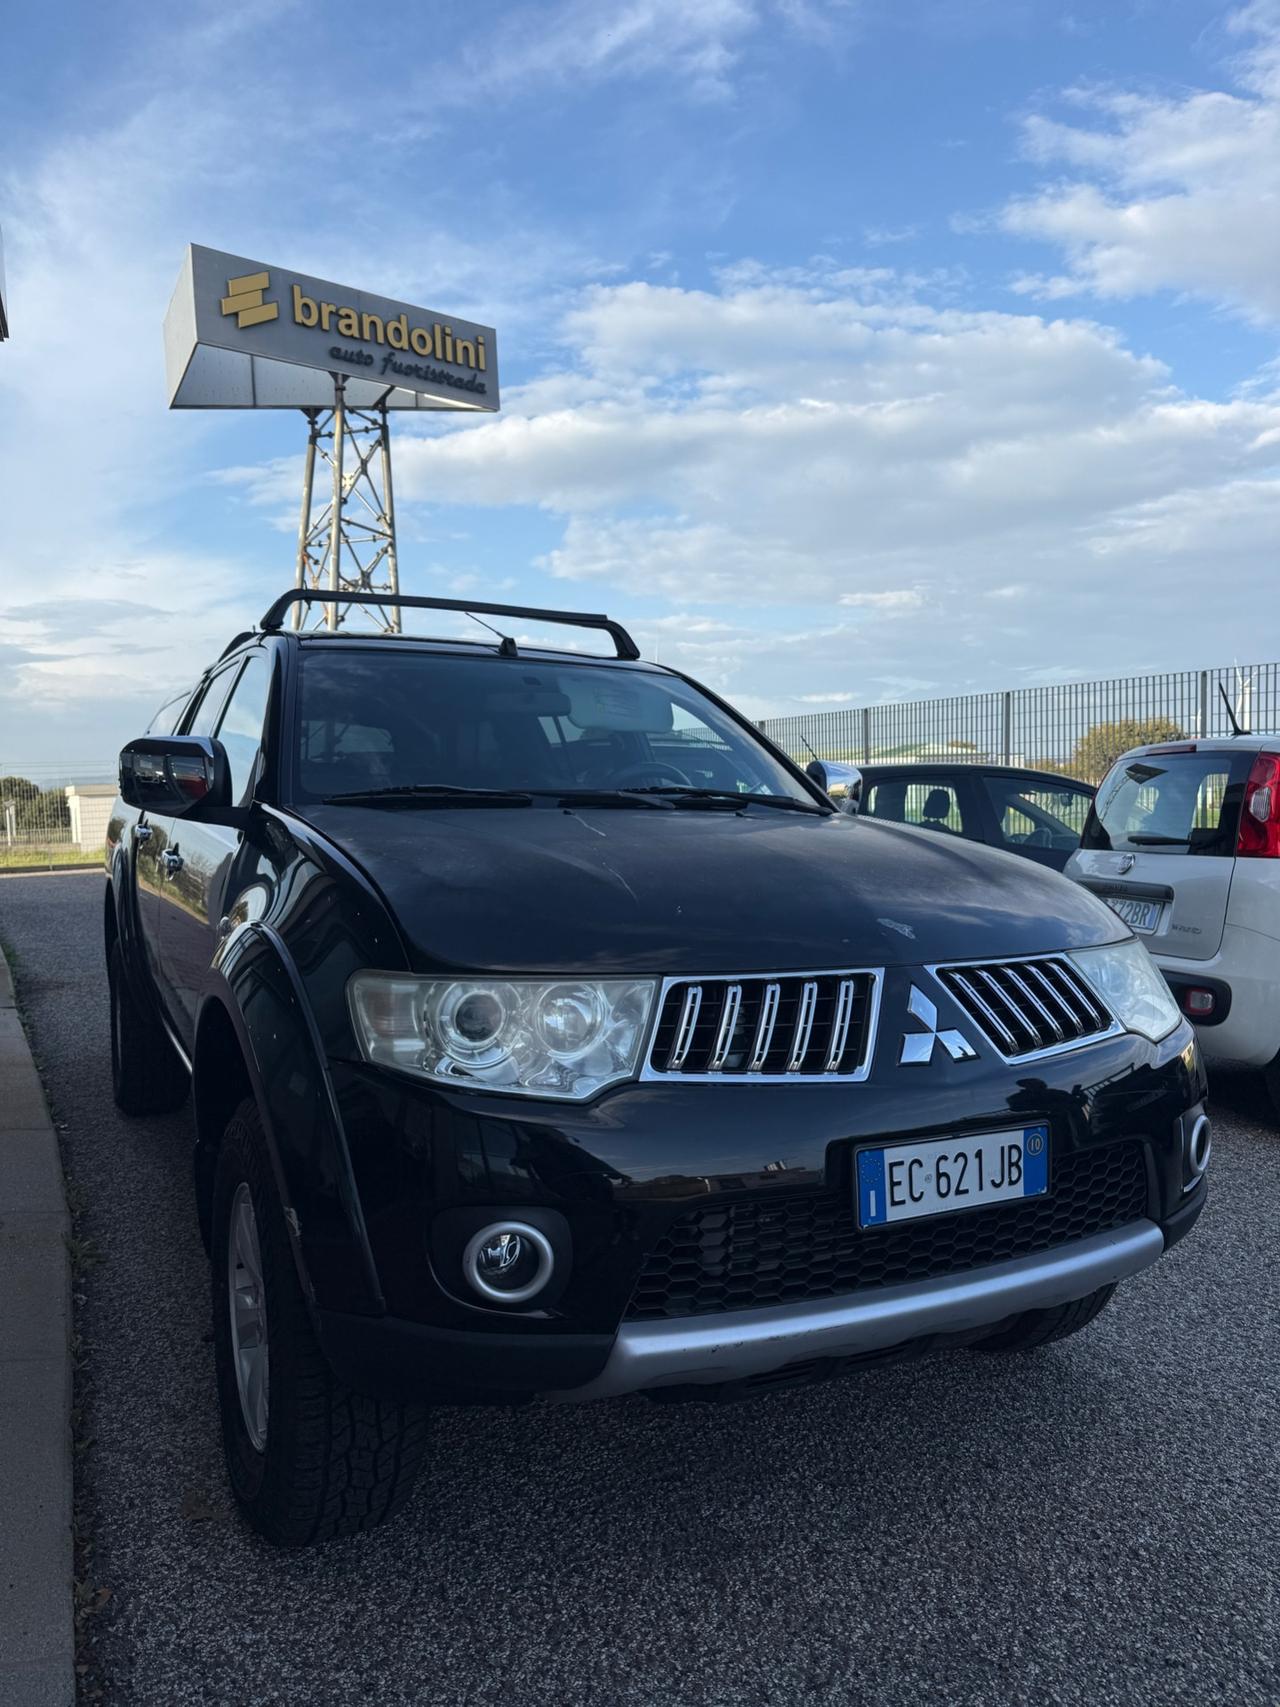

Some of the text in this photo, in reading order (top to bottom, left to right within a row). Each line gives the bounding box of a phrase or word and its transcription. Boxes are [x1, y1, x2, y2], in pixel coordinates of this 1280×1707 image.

[291, 284, 487, 371] brandolini
[328, 346, 487, 394] auto fuoristrada
